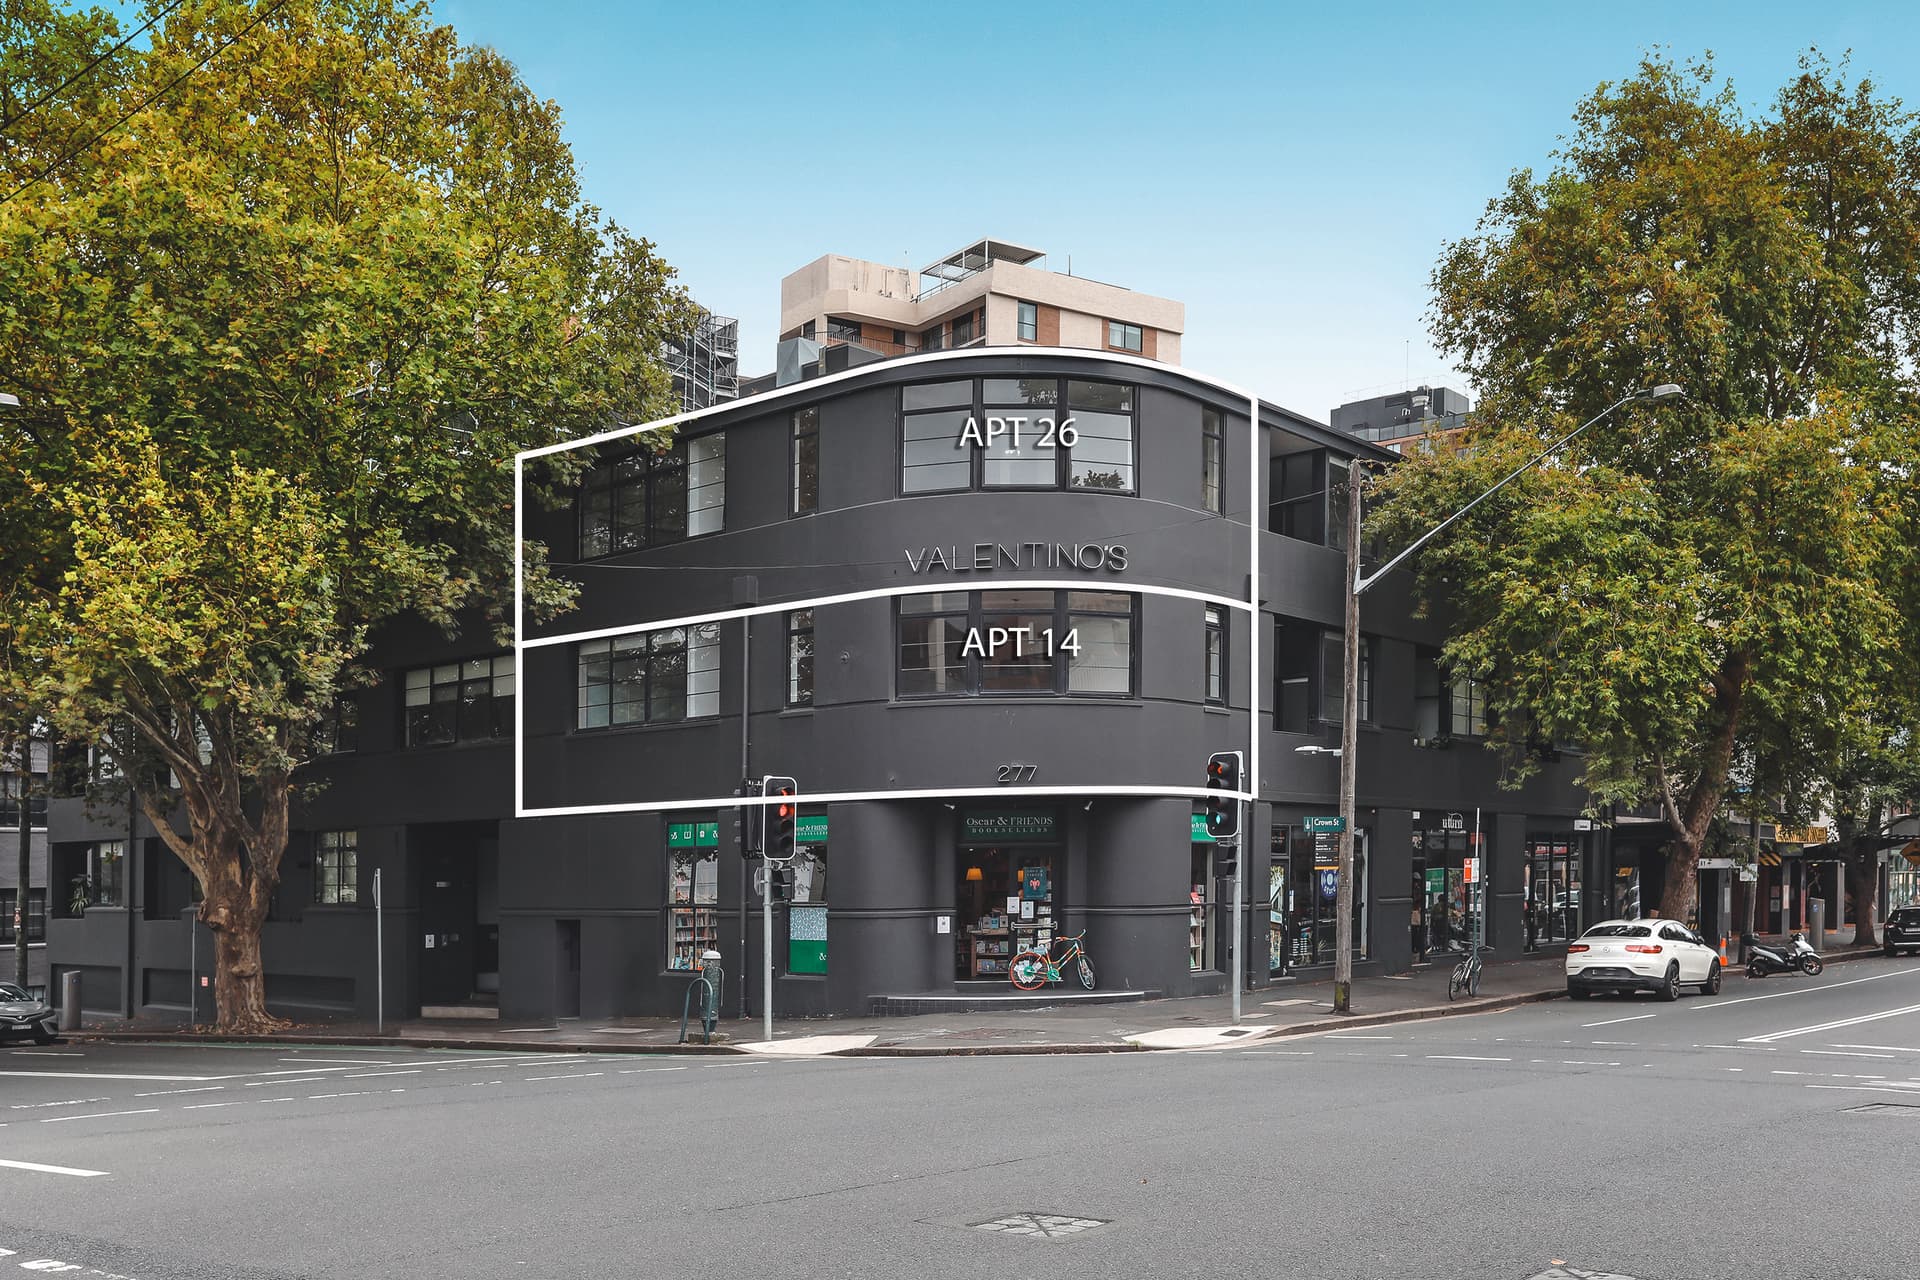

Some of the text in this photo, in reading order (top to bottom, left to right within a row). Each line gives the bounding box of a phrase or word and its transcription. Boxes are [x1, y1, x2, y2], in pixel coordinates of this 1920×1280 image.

[904, 542, 1129, 573] VALENTINO'S
[997, 764, 1038, 782] 277
[966, 816, 1053, 826] Oscar & FRIENDS
[1313, 818, 1340, 826] Crown St
